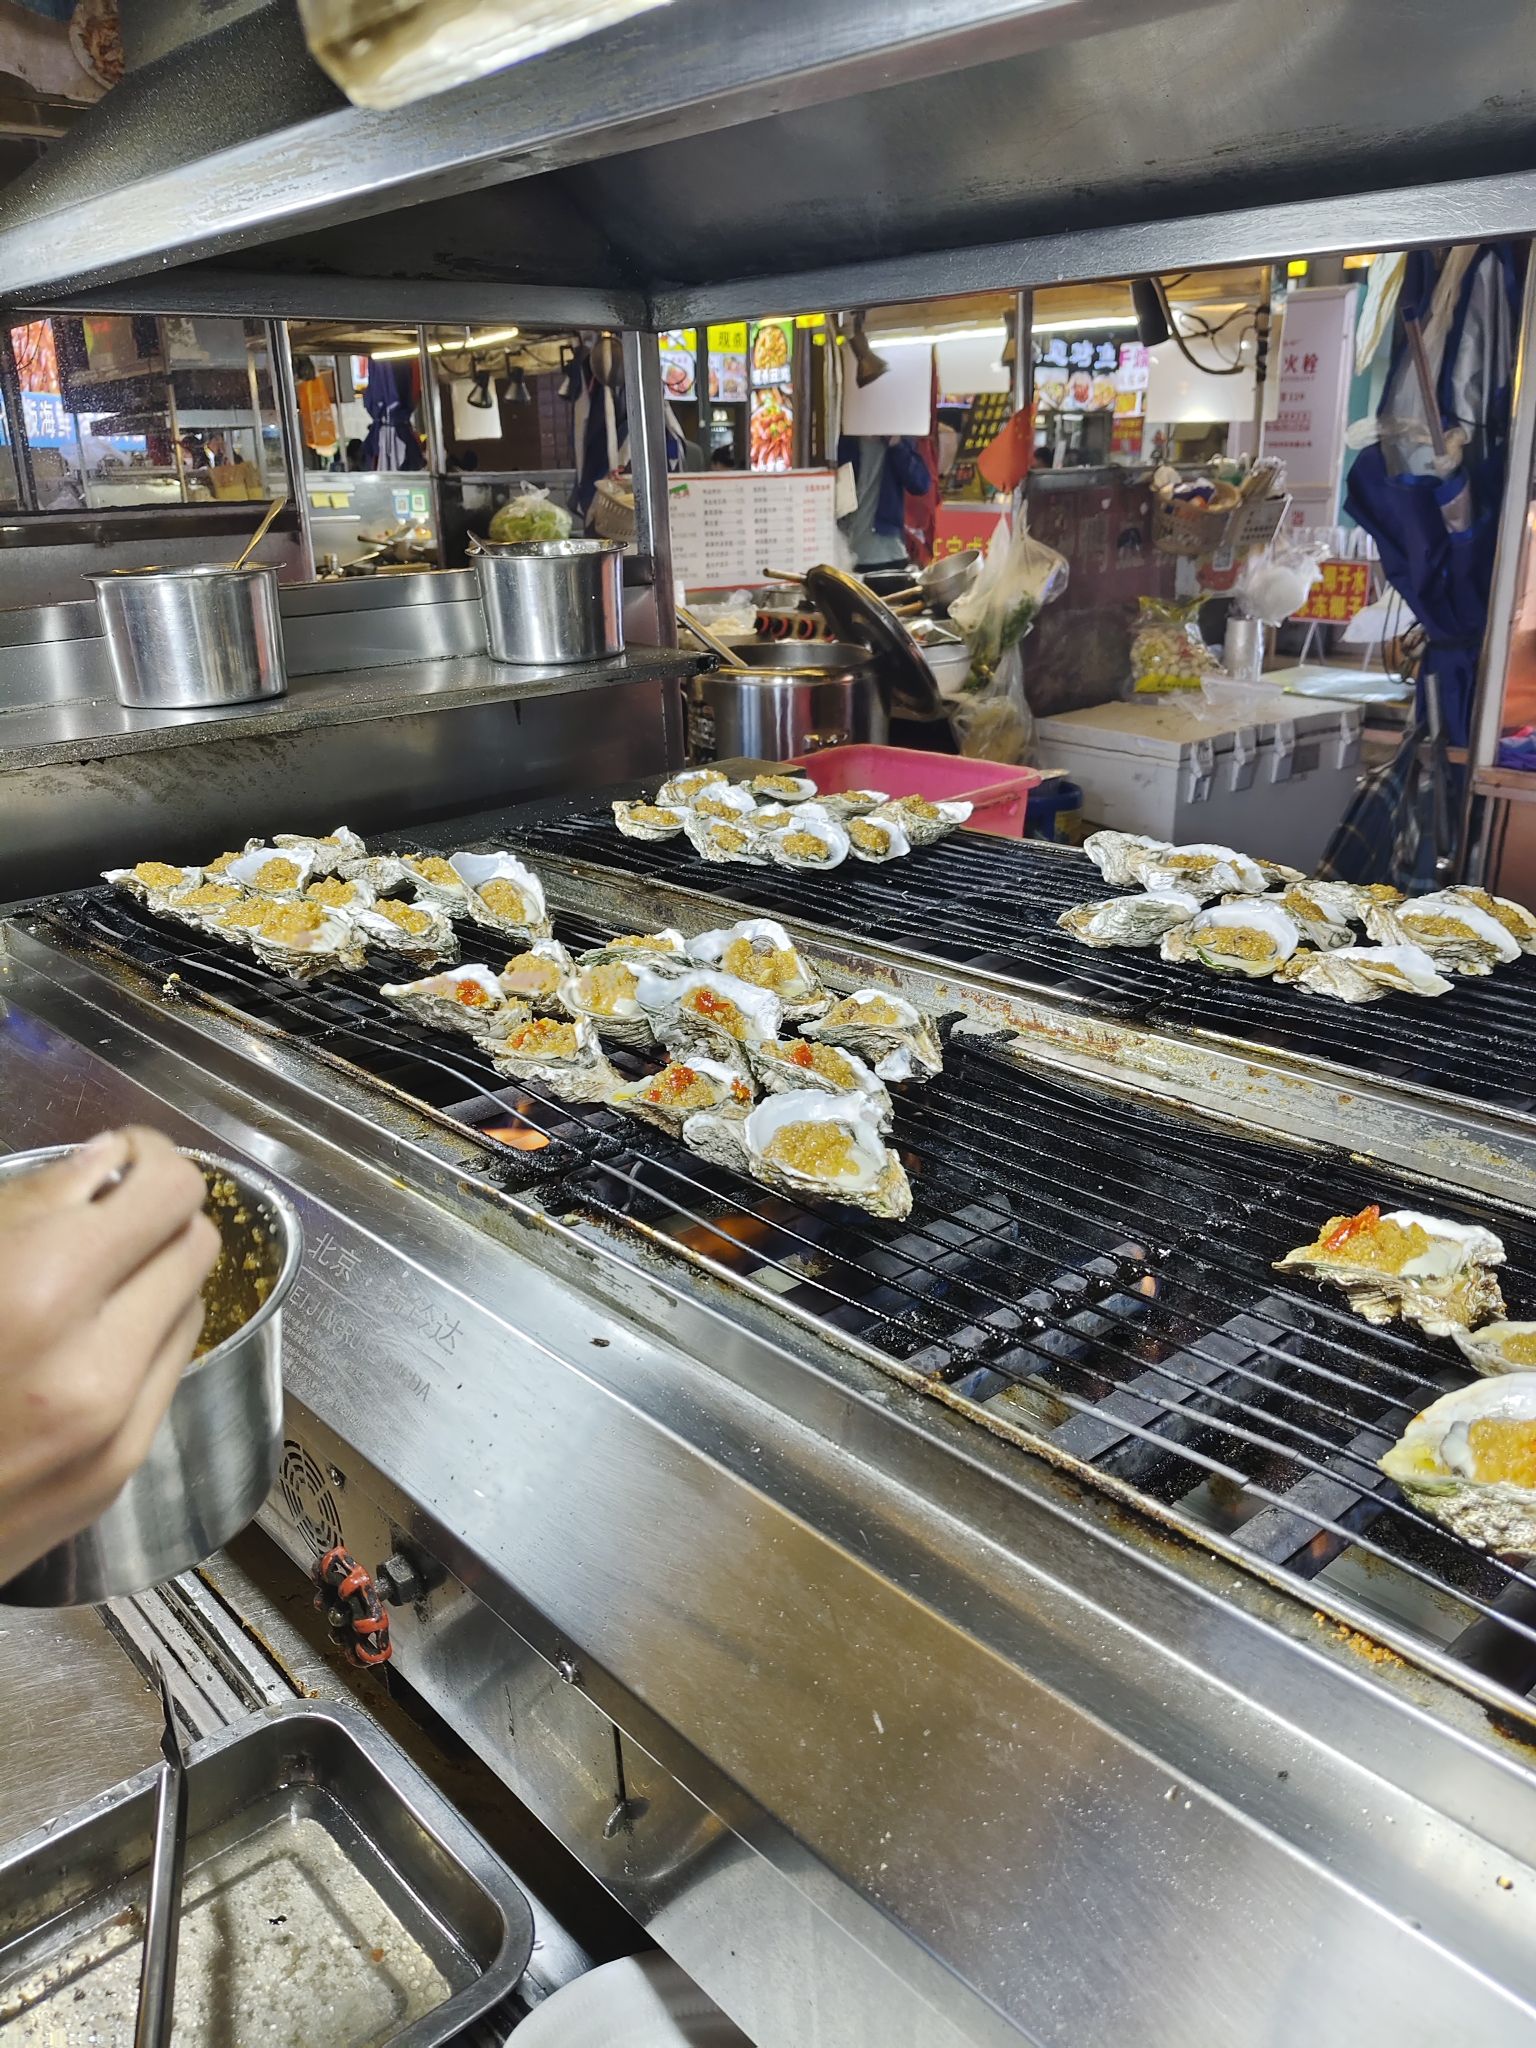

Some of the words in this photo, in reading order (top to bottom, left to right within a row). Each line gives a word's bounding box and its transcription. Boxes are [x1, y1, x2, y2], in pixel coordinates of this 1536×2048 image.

[1311, 563, 1366, 594] 椰子水
[307, 1232, 362, 1281] 北京
